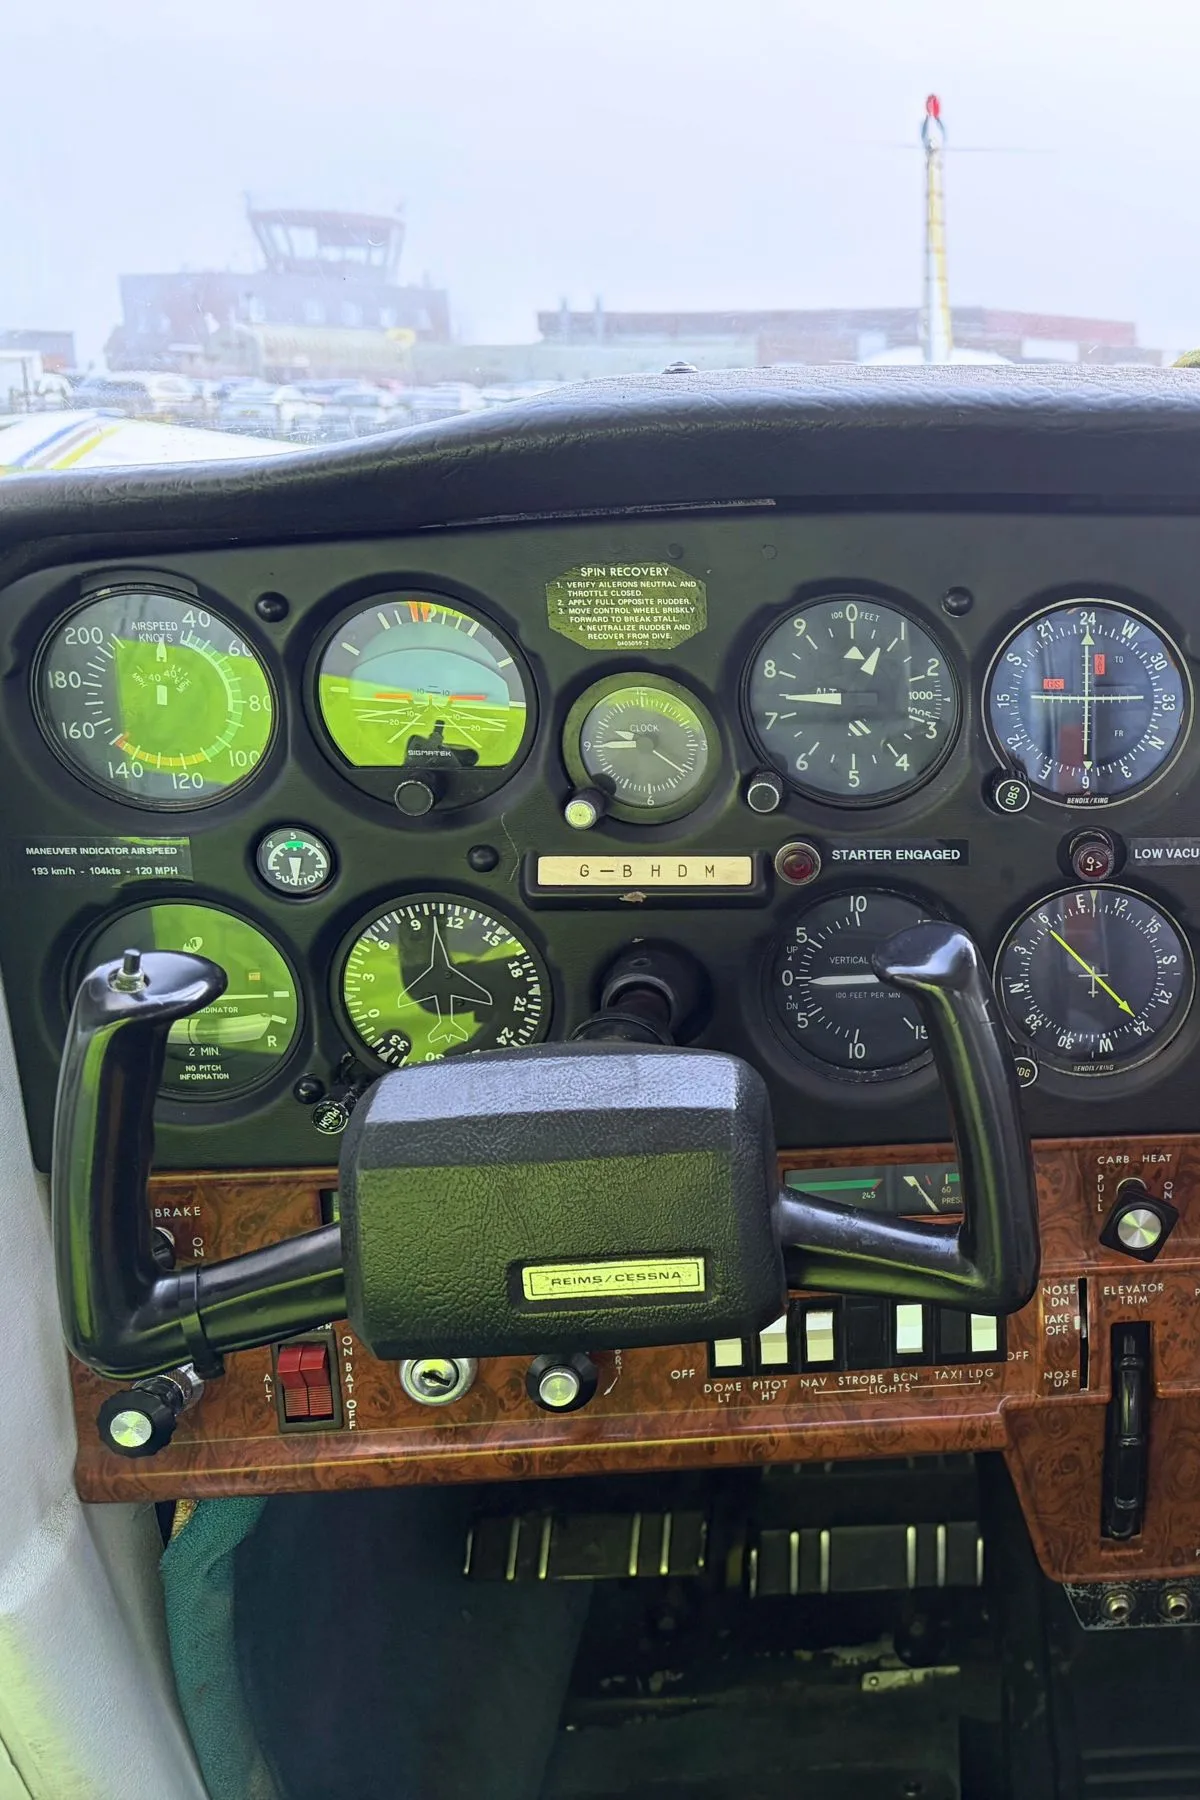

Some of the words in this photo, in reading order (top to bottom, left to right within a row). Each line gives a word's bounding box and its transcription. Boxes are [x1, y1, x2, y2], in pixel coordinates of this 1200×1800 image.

[581, 568, 605, 576] SPIN
[611, 567, 669, 576] RECOVERY
[182, 611, 210, 627] 40
[131, 622, 178, 631] AIRSPEED
[65, 627, 103, 644] 200
[48, 671, 80, 688] 180
[62, 722, 95, 738] 160
[108, 762, 143, 778] 140
[172, 773, 203, 789] 120
[832, 850, 891, 860] STARTER
[896, 850, 960, 860] ENGAGED
[1135, 849, 1162, 859] LOW
[52, 867, 75, 875] km/h
[89, 867, 121, 875] 104kts
[829, 956, 868, 964] VERTICAL
[1098, 1156, 1130, 1164] CARB
[1142, 1154, 1172, 1163] HEAT
[154, 1206, 201, 1218] BRAKE
[551, 1272, 681, 1286] REIMS/CESSNA
[1104, 1283, 1164, 1295] ELEVATOR
[1120, 1296, 1148, 1305] TRIM
[838, 1374, 883, 1385] STROBE
[968, 1369, 994, 1378] LDG
[704, 1382, 742, 1393] DOME
[752, 1380, 788, 1391] PITOT
[869, 1383, 911, 1395] LIGHTS
